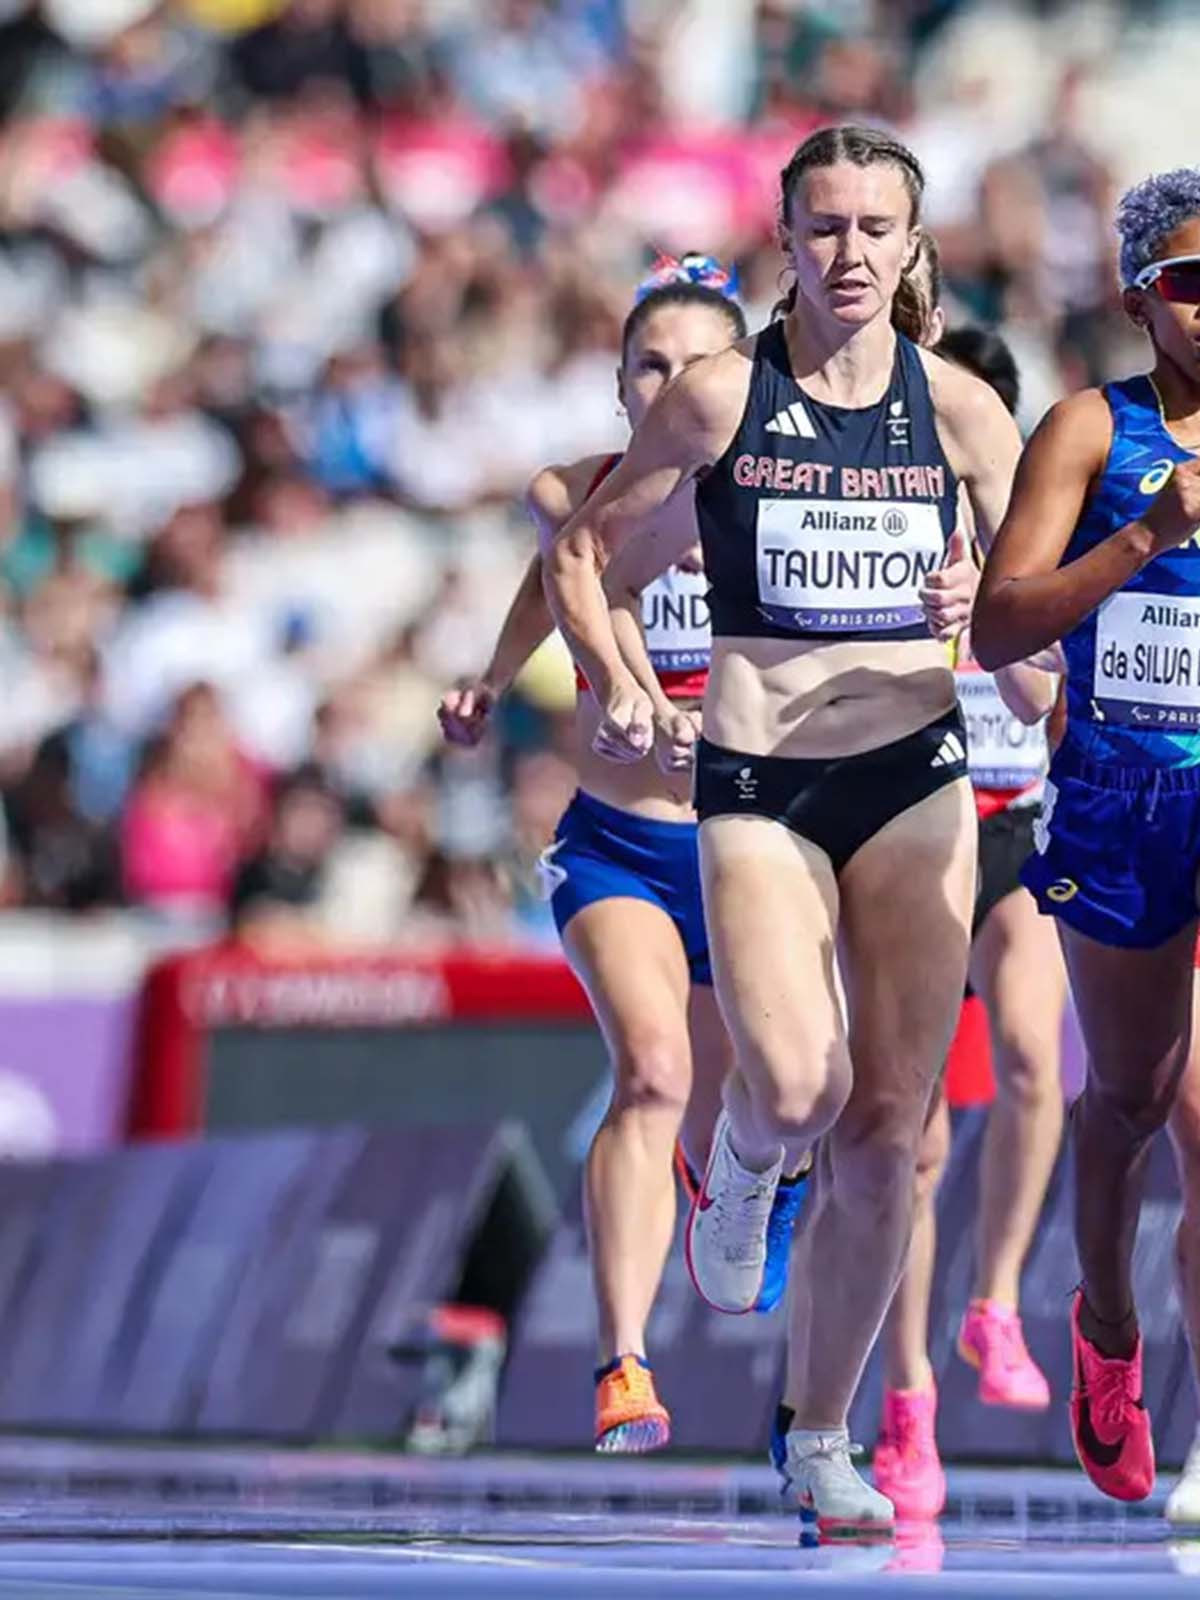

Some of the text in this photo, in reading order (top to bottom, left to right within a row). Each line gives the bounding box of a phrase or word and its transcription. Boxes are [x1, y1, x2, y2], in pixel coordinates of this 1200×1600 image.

[733, 453, 945, 499] GREAT BRITAIN
[800, 510, 877, 532] Allianz
[763, 548, 937, 590] TAUNTON
[643, 593, 711, 631] UND
[819, 612, 901, 626] PARIS 2024
[1101, 640, 1128, 680] da
[1133, 643, 1192, 686] SILVA
